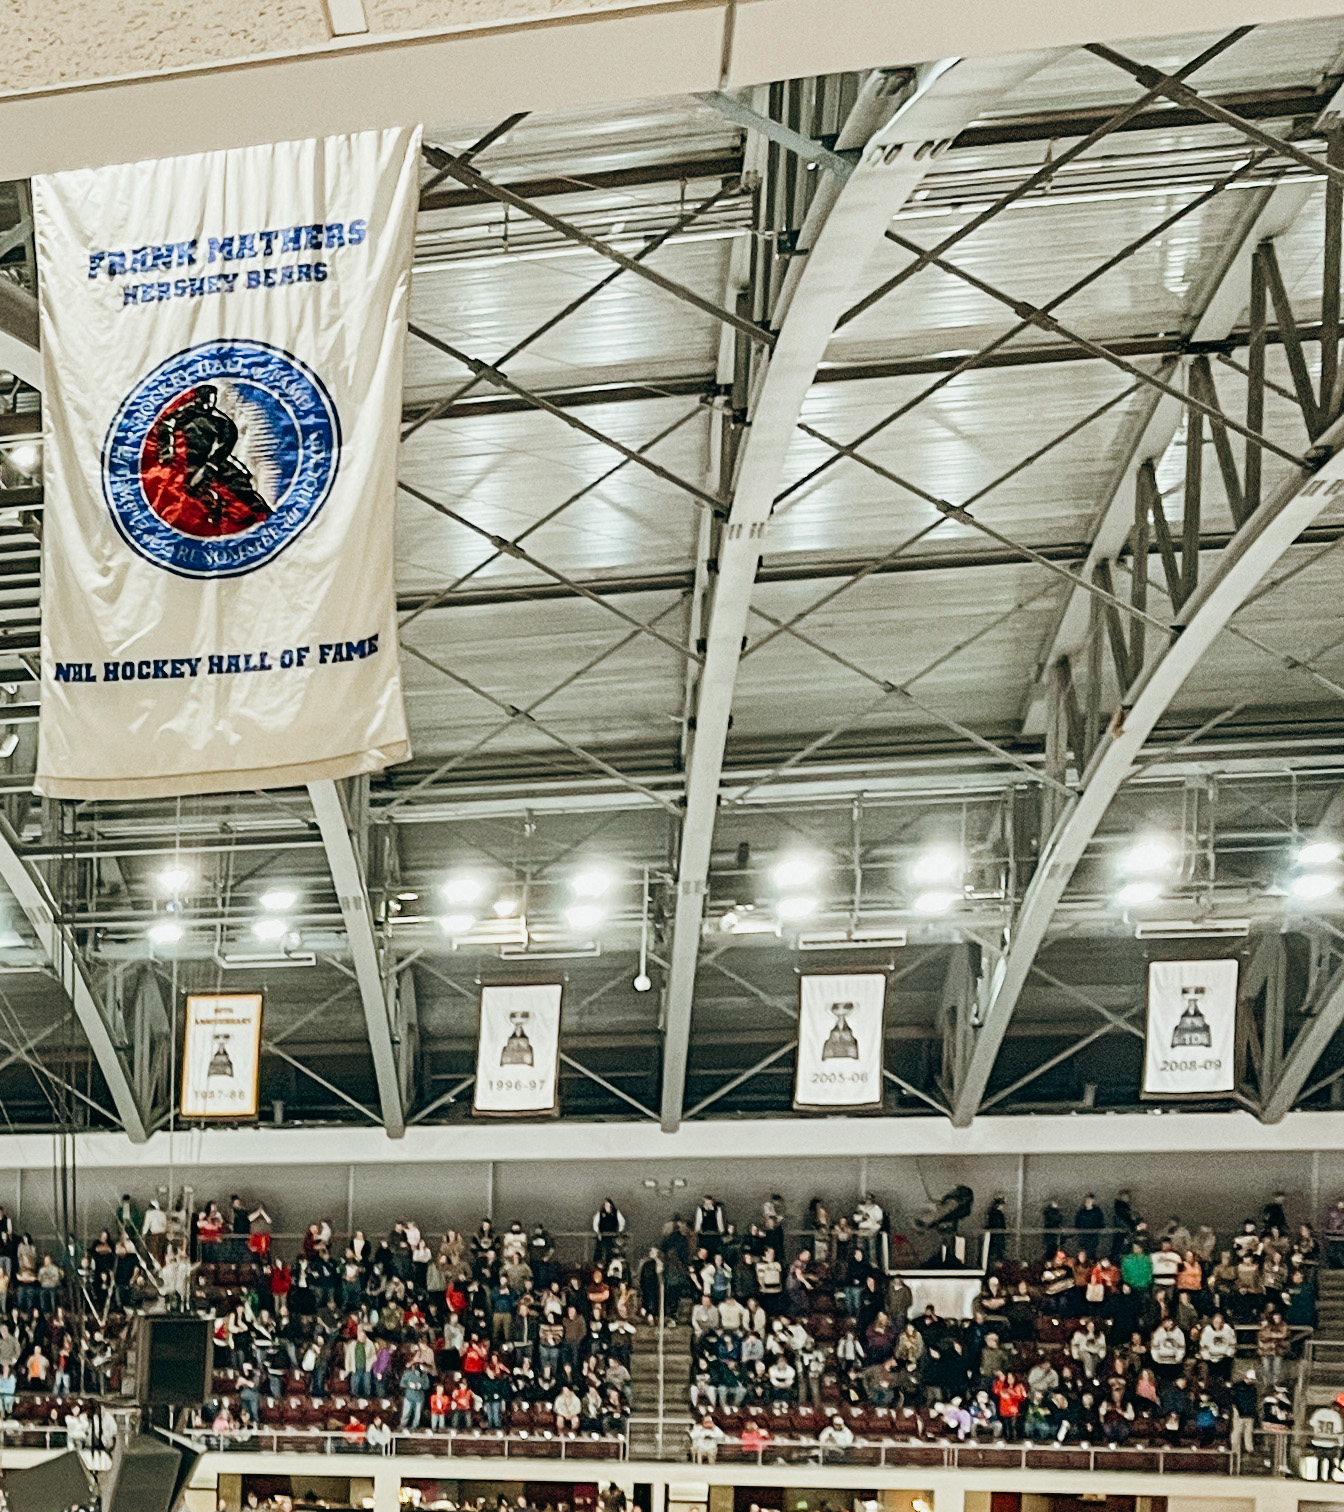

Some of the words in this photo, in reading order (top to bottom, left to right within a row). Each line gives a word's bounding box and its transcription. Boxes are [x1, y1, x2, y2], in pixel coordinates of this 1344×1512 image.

[88, 239, 197, 279] FRANK
[207, 219, 367, 263] MATHERS
[123, 273, 238, 306] HERSHEY
[246, 262, 328, 289] BEARS
[54, 662, 97, 682] NHL
[103, 657, 201, 682] HOCKEY
[207, 651, 272, 675] HALL
[279, 646, 310, 669] OF
[319, 634, 378, 664] FAME
[488, 1080, 546, 1091] 1996-97
[1159, 1060, 1222, 1072] 2008-09
